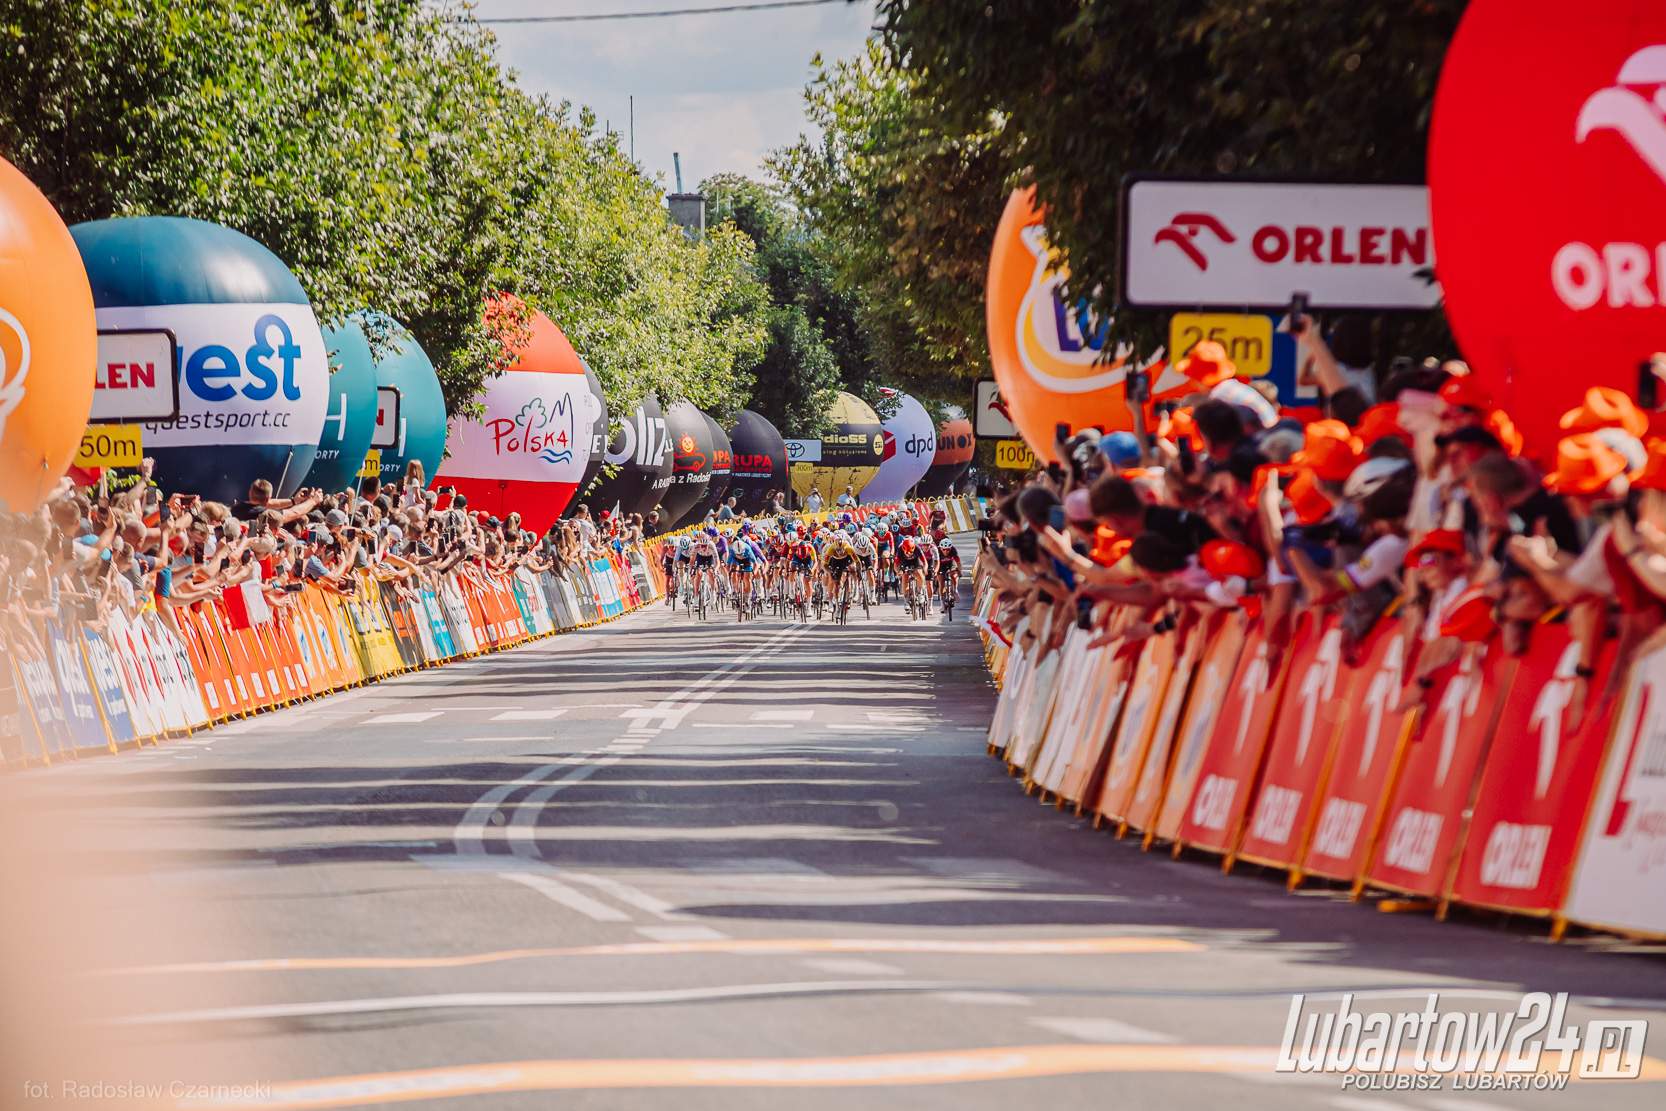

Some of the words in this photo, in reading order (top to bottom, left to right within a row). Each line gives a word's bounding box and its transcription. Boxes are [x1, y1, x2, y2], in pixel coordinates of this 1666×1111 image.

[1252, 225, 1427, 265] ORLEN
[80, 435, 137, 457] 50m
[905, 431, 934, 458] dpd
